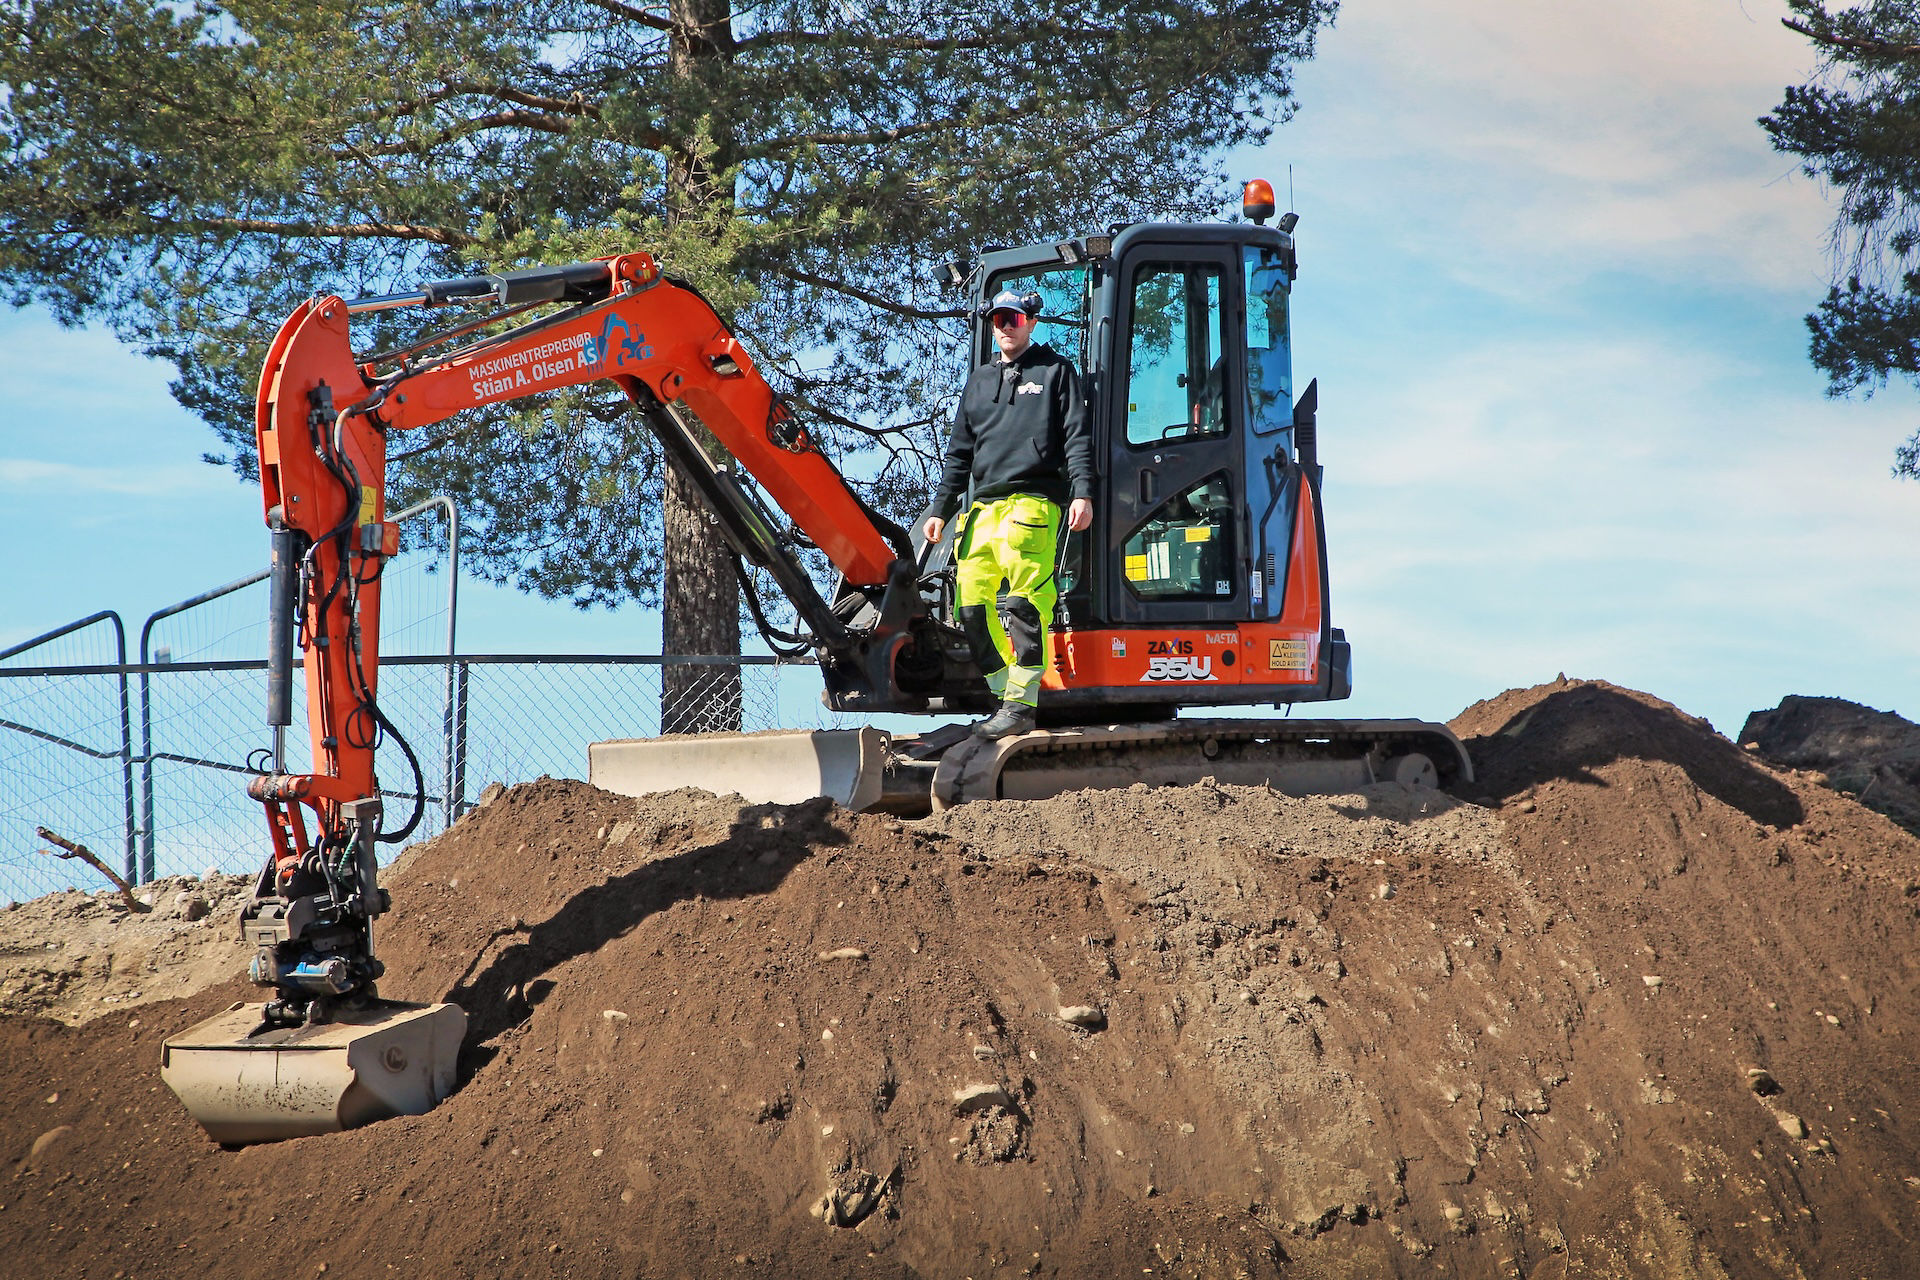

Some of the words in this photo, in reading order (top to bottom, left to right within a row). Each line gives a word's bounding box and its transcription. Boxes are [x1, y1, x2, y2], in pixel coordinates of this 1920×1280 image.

[469, 332, 593, 380] MASKINENTREPRENØR
[473, 376, 513, 400] Stian
[516, 369, 531, 387] A.
[532, 357, 575, 381] Olsen
[577, 347, 598, 368] AS
[1148, 639, 1193, 654] ZAXIS
[1206, 633, 1239, 644] NASTA
[1148, 656, 1212, 680] 55U
